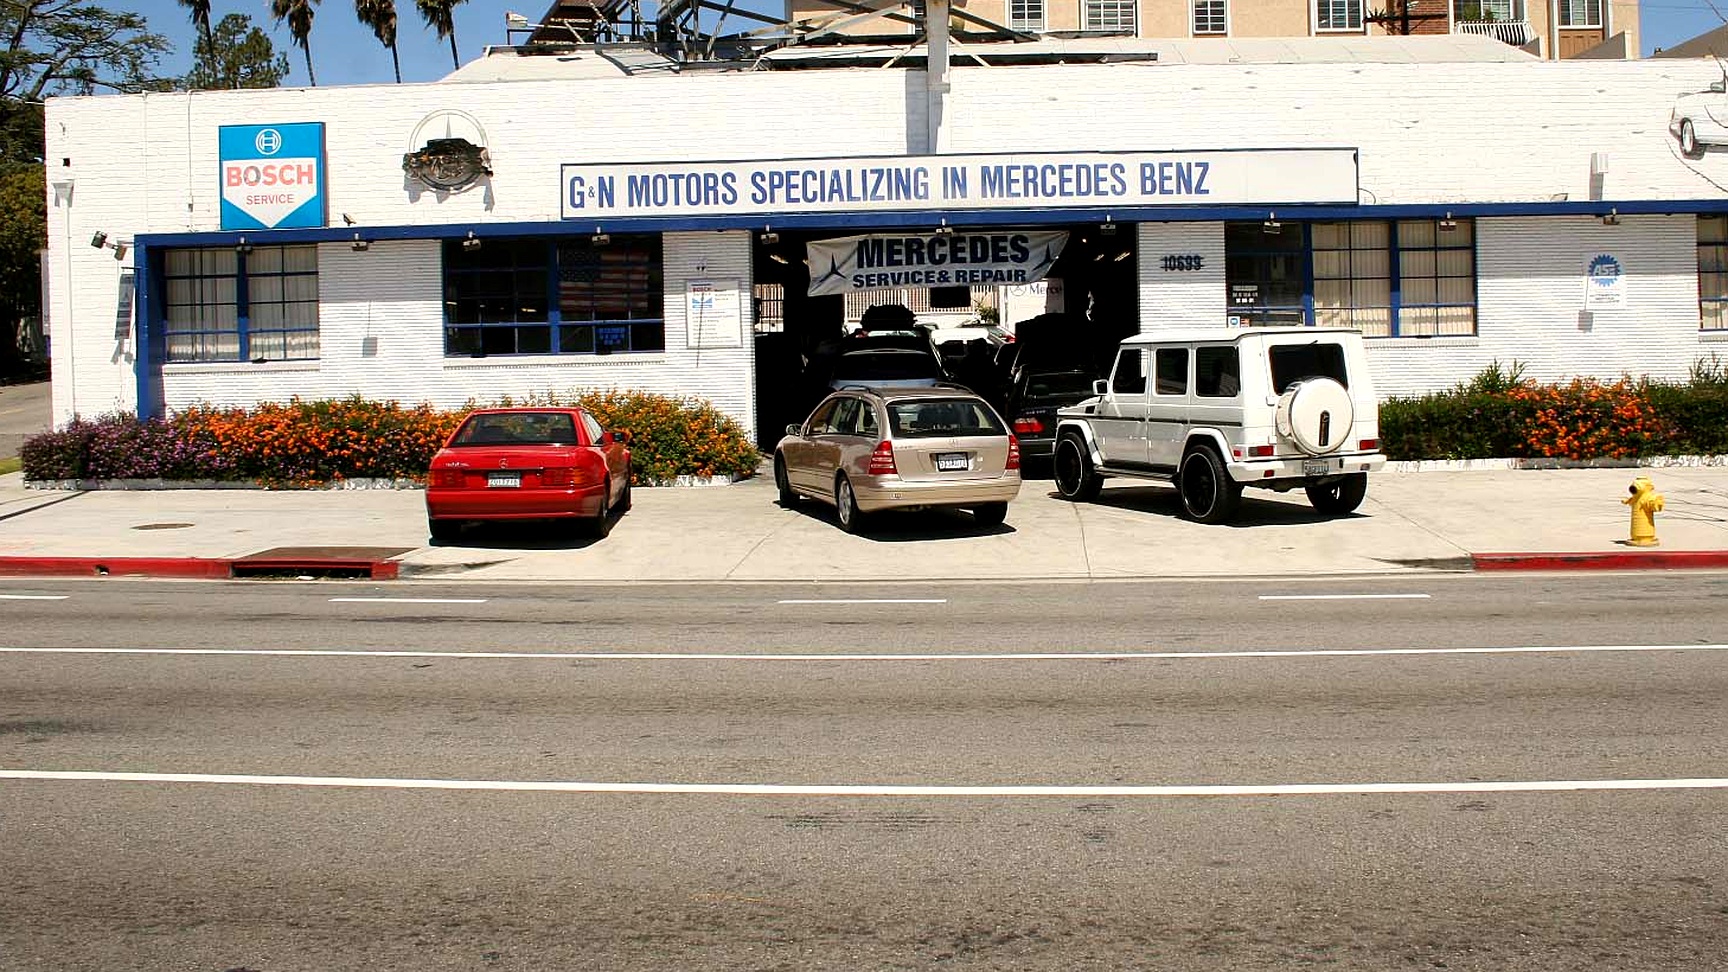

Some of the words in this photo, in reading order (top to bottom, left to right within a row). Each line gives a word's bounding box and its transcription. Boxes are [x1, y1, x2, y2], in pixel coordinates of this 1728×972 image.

[226, 164, 314, 187] BOSCH
[628, 172, 738, 207] MOTORS
[751, 167, 929, 205] SPECIALIZING
[942, 167, 967, 199] IN
[981, 163, 1127, 198] MERCEDES
[1140, 162, 1210, 195] BENZ
[246, 194, 295, 206] SERVICE
[856, 234, 1030, 269] MERCEDES
[1162, 255, 1202, 272] 10699
[955, 269, 1027, 283] REPAIR
